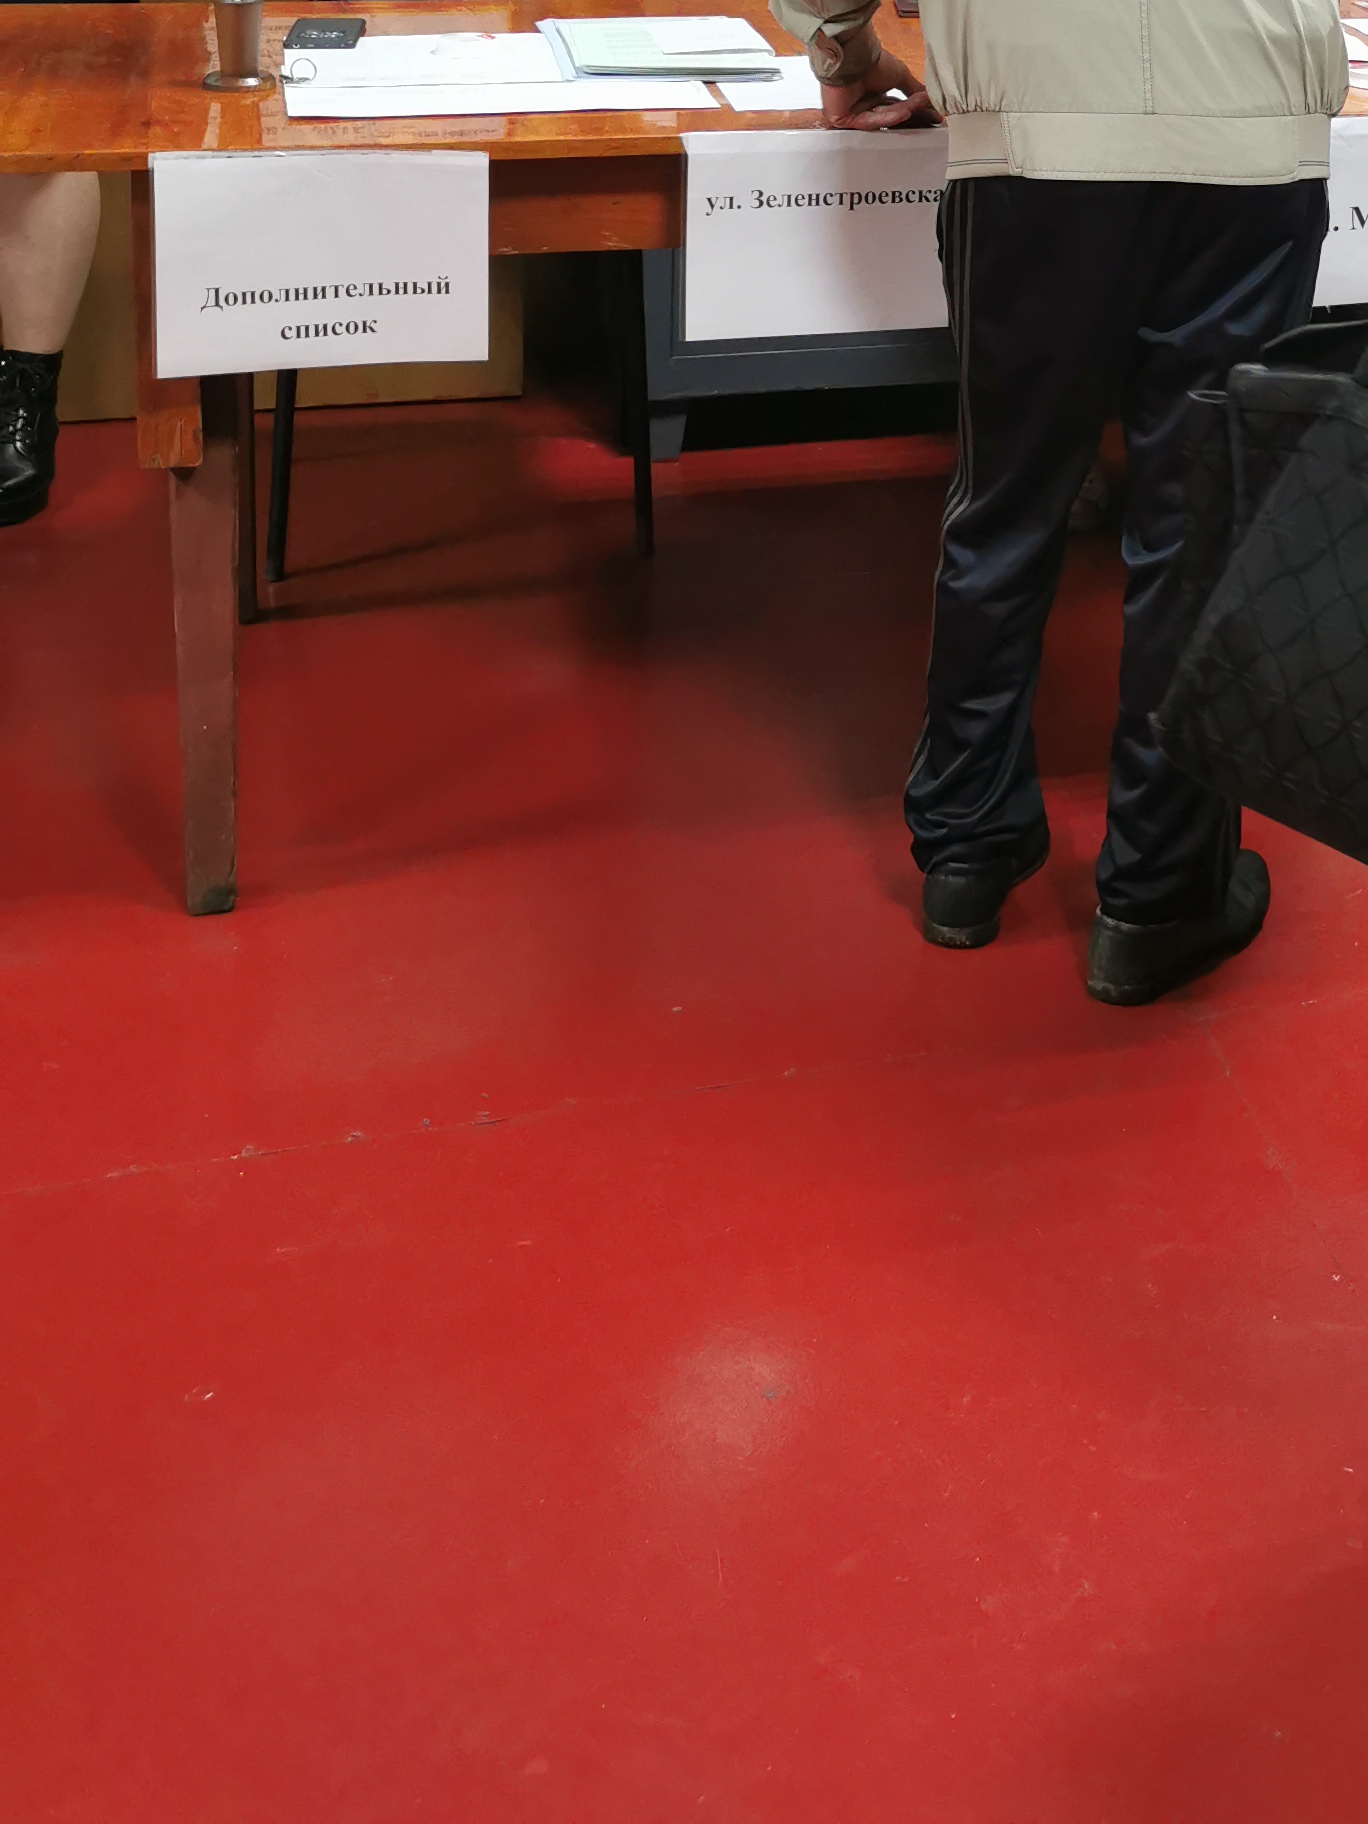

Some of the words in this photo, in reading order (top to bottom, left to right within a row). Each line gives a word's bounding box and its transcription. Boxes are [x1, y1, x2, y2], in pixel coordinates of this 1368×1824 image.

[705, 196, 742, 216] ул.
[750, 188, 945, 211] Зеленстроевска
[200, 276, 451, 313] Дополнительный
[280, 319, 378, 340] список
